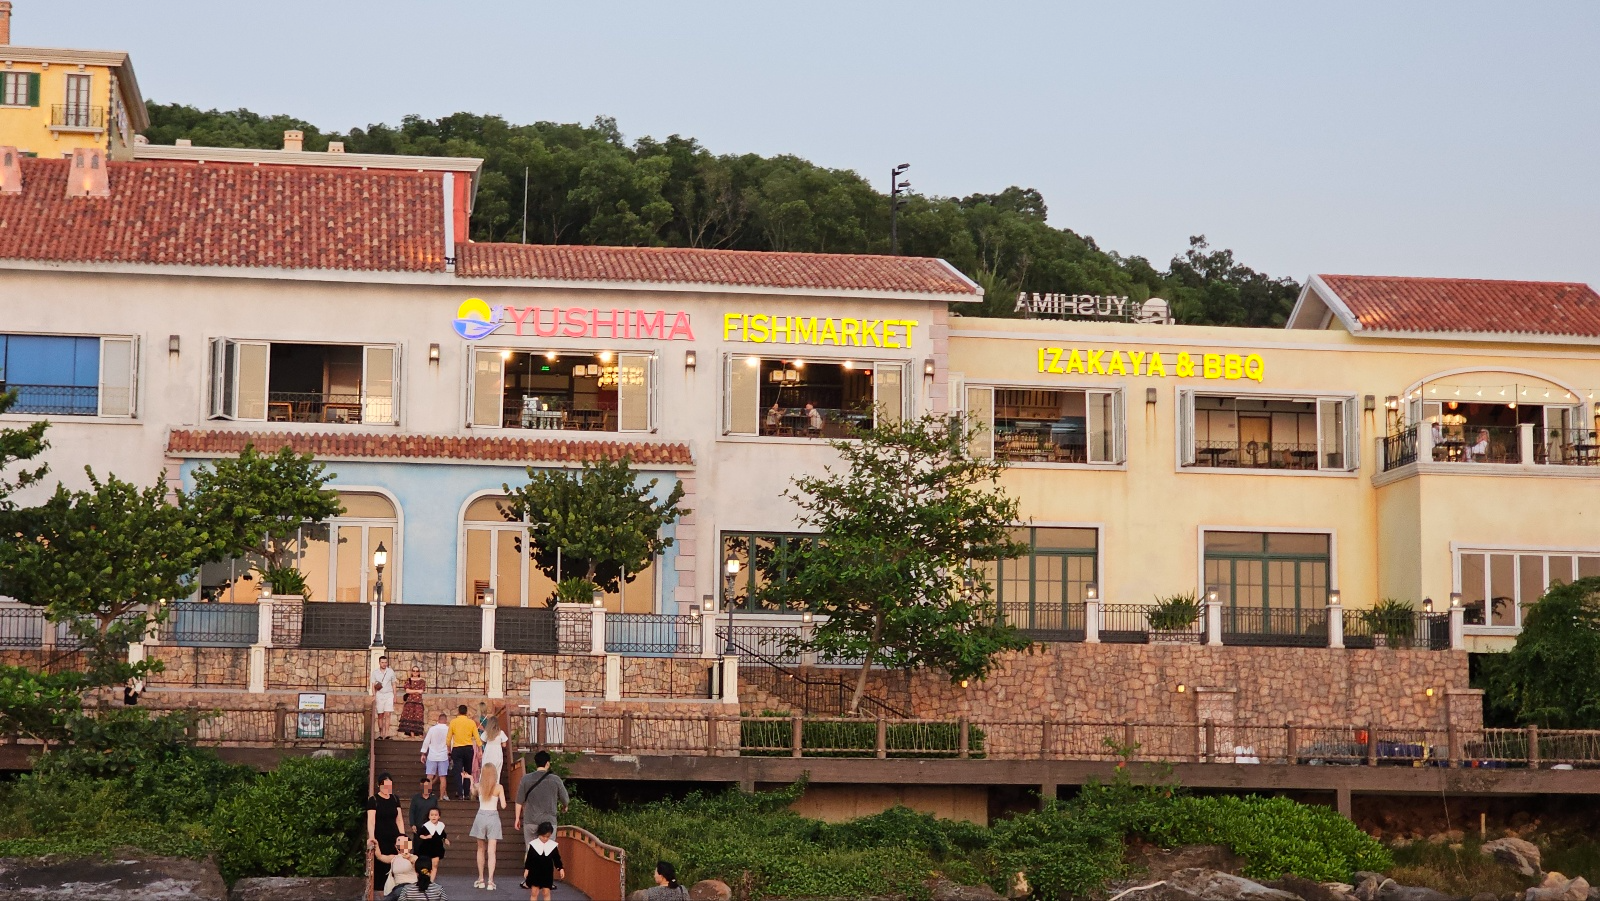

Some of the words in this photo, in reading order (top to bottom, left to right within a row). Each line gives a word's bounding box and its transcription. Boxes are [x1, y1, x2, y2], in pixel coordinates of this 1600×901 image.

[506, 306, 695, 341] YUSHIMA
[723, 313, 919, 349] FISHMARKET
[1038, 347, 1166, 377] IZAKAYA
[1175, 351, 1195, 378] &
[1203, 353, 1265, 383] BBQ
